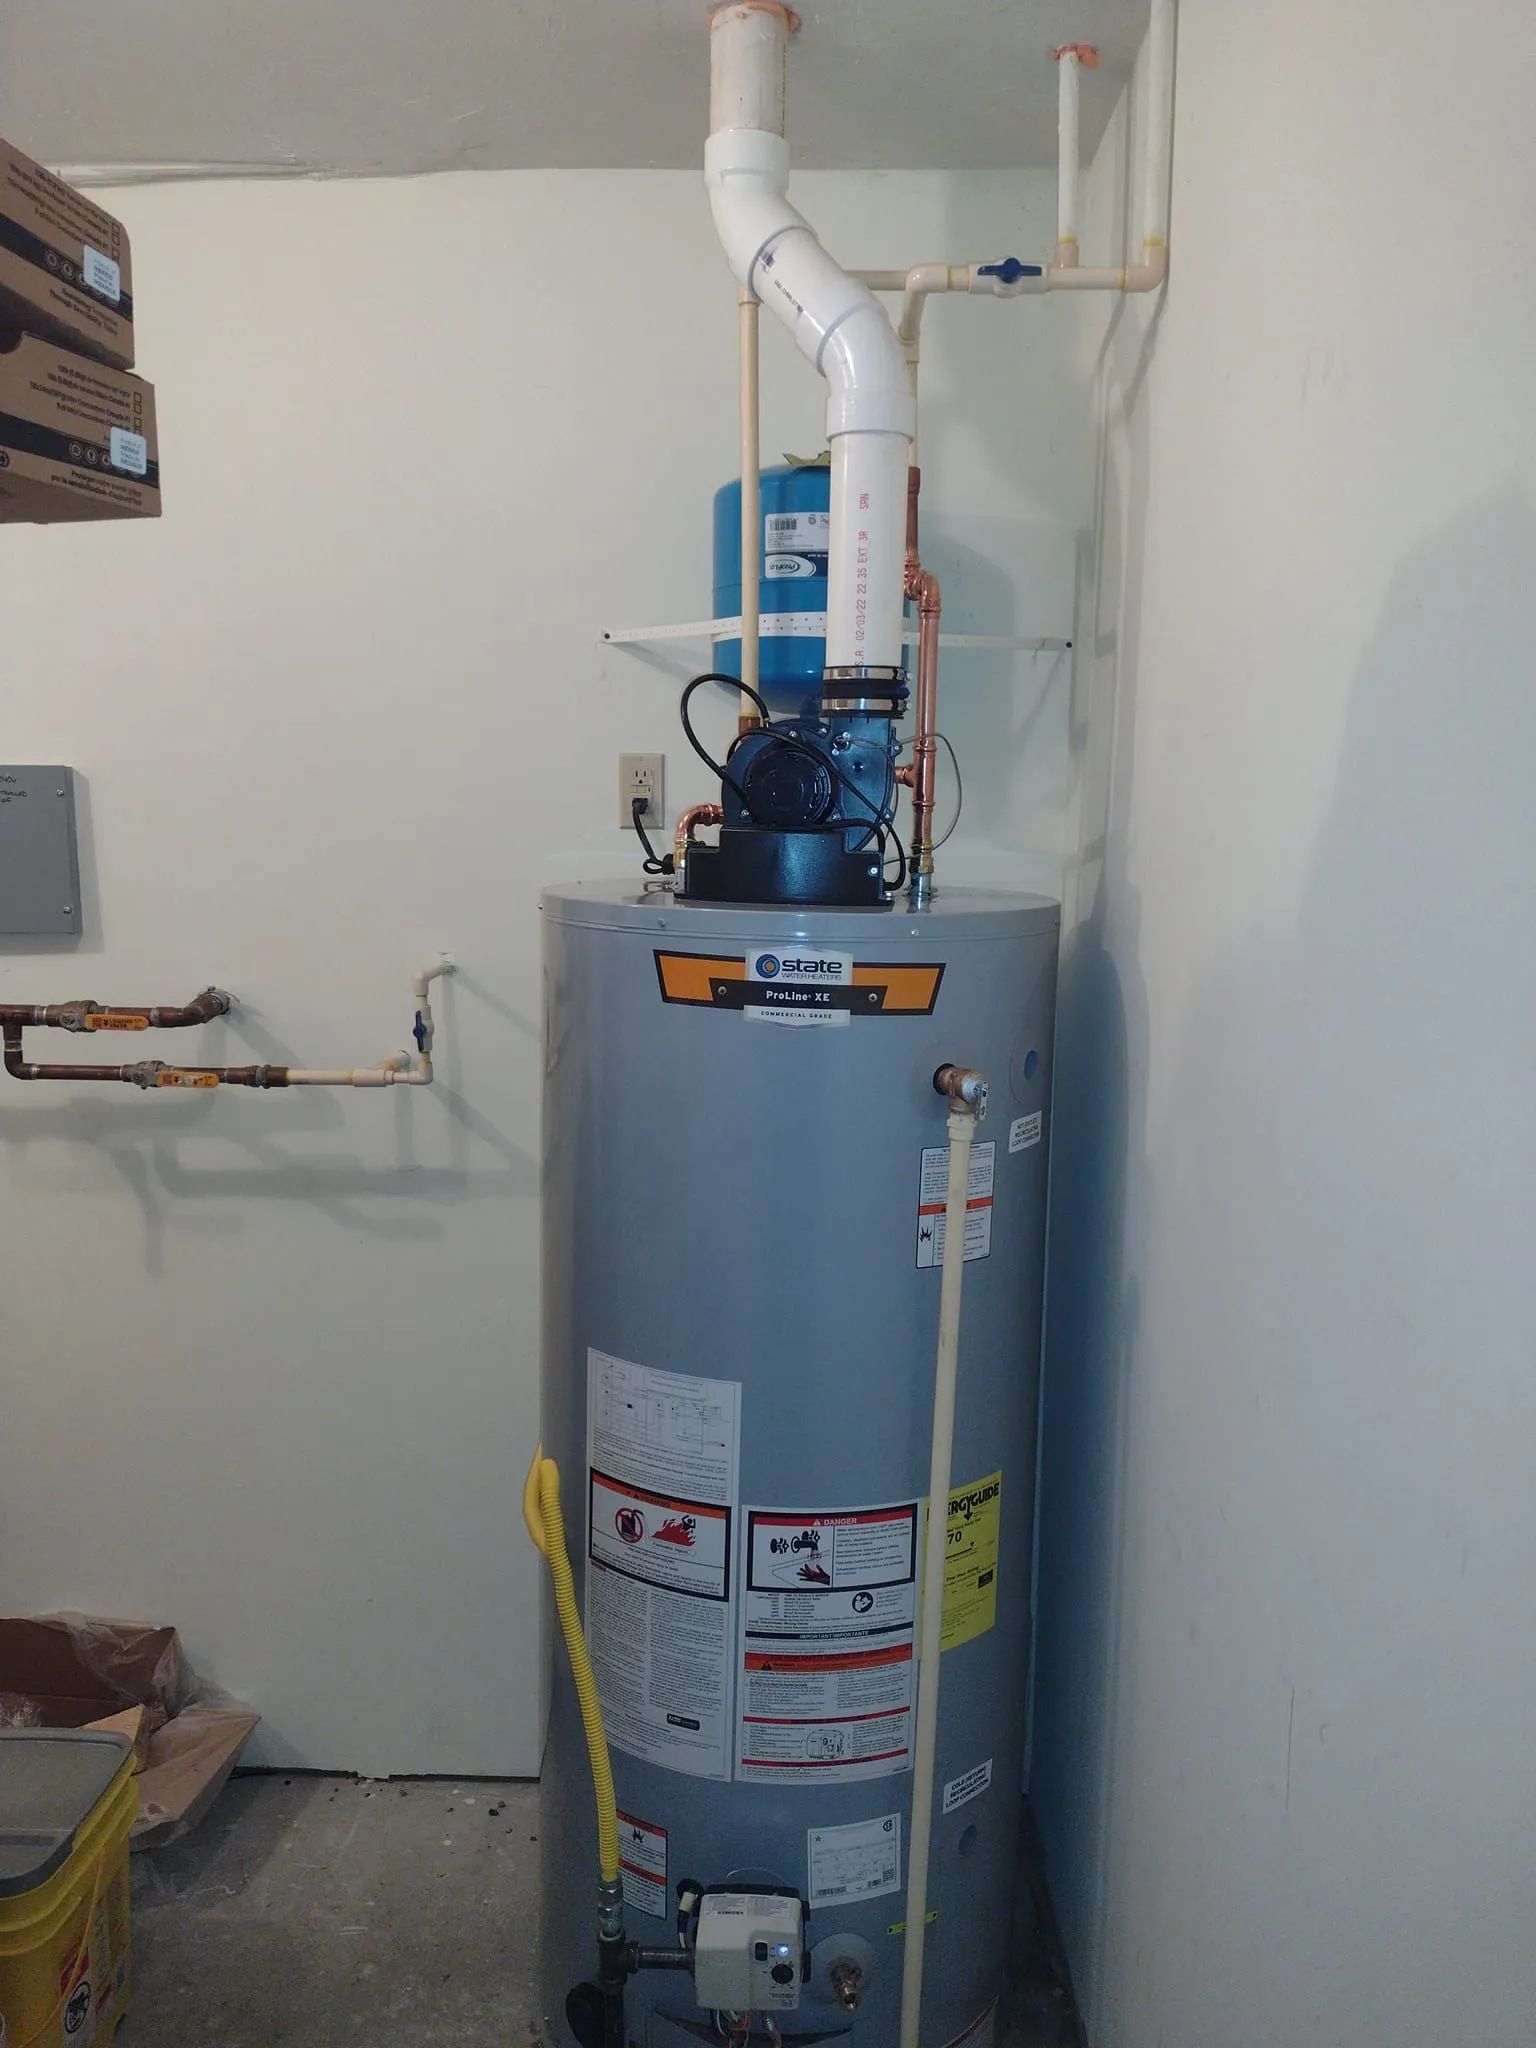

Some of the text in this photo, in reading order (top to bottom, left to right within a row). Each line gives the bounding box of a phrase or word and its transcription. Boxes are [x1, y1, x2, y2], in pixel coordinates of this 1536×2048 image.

[857, 547, 868, 564] EXT
[857, 567, 867, 578] 35
[857, 583, 867, 595] 22
[855, 598, 867, 641] 02/03/22
[782, 959, 842, 974] state
[815, 993, 830, 1001] XE
[824, 1517, 857, 1526] DANGER
[952, 1779, 964, 1790] COLD
[945, 1779, 989, 1808] LOOP CONNECTION
